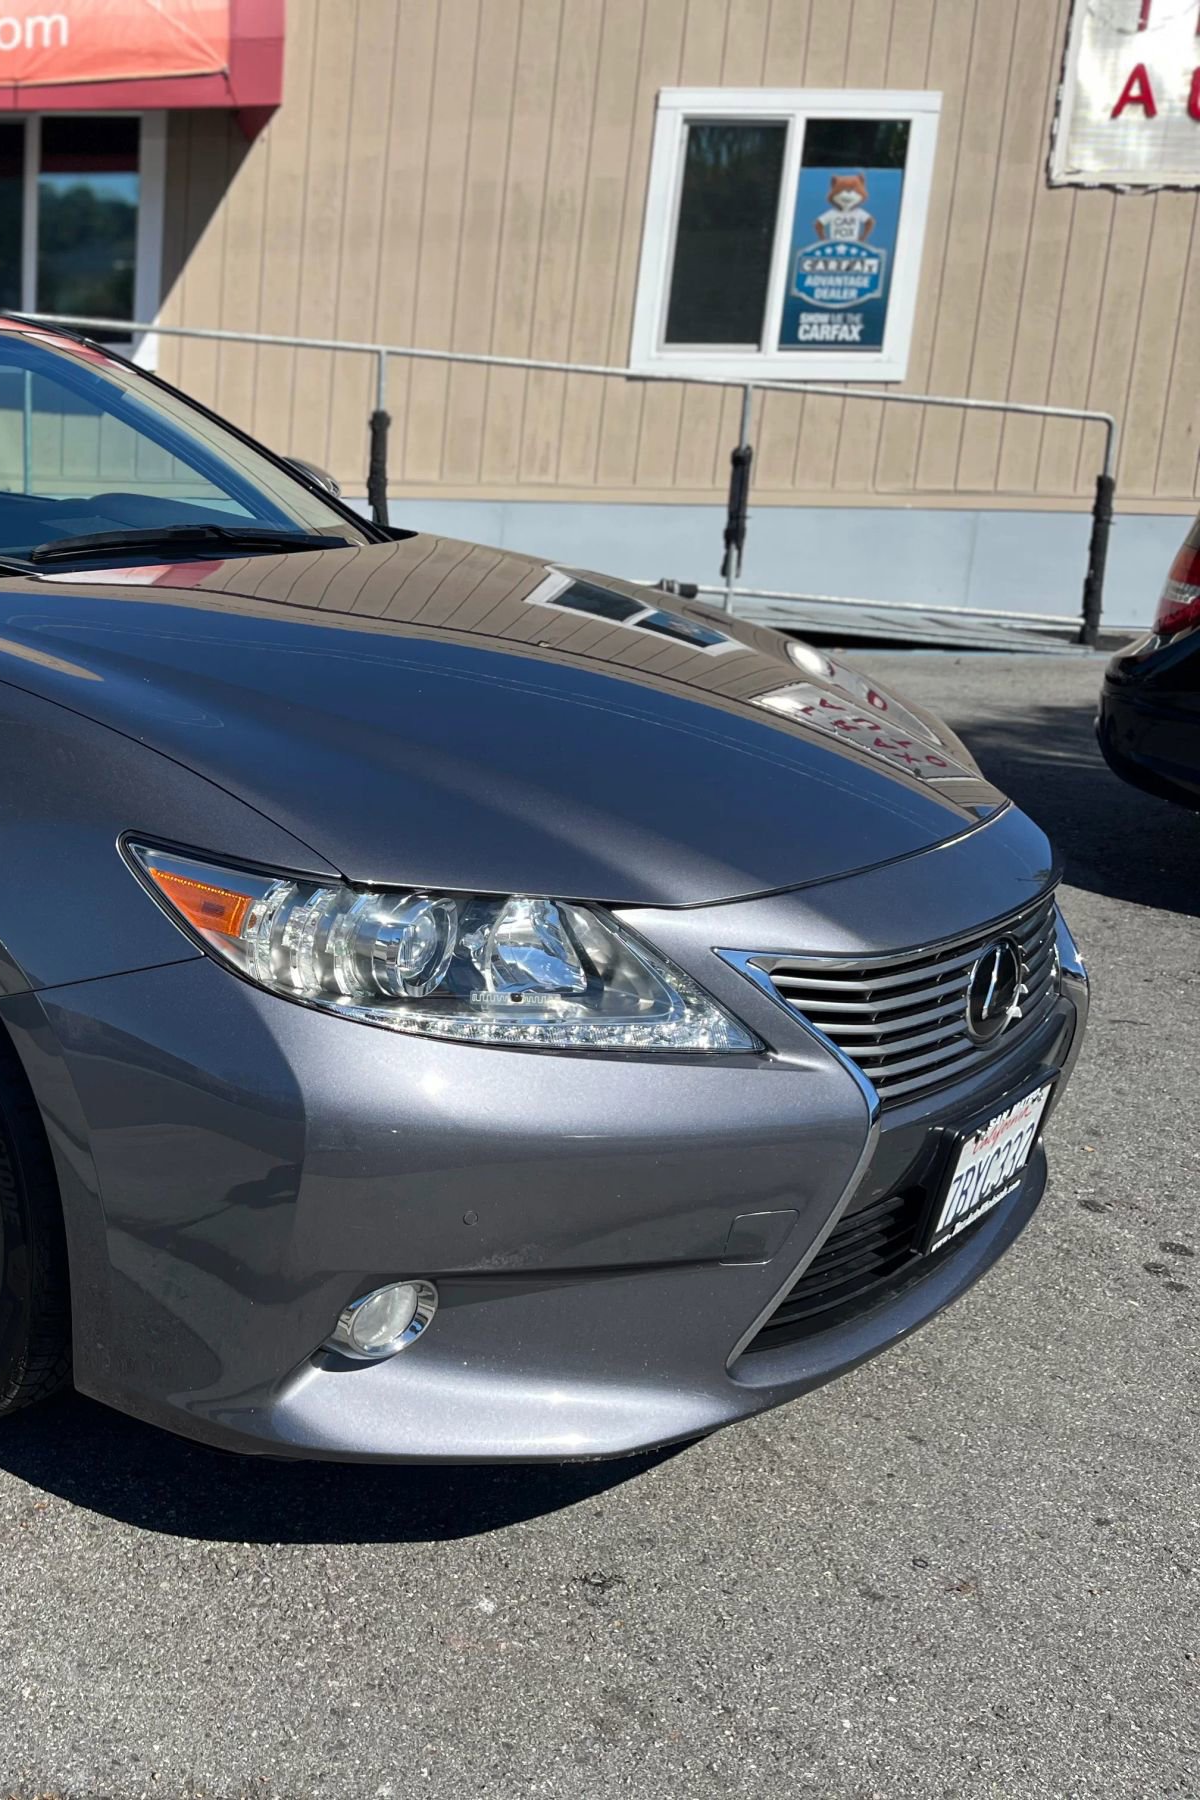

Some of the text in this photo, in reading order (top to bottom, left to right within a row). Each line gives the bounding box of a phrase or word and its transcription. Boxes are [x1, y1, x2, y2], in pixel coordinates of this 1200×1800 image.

[802, 259, 879, 274] CARFAX
[804, 275, 871, 288] ADVANTAGE
[798, 323, 864, 341] CARFAX
